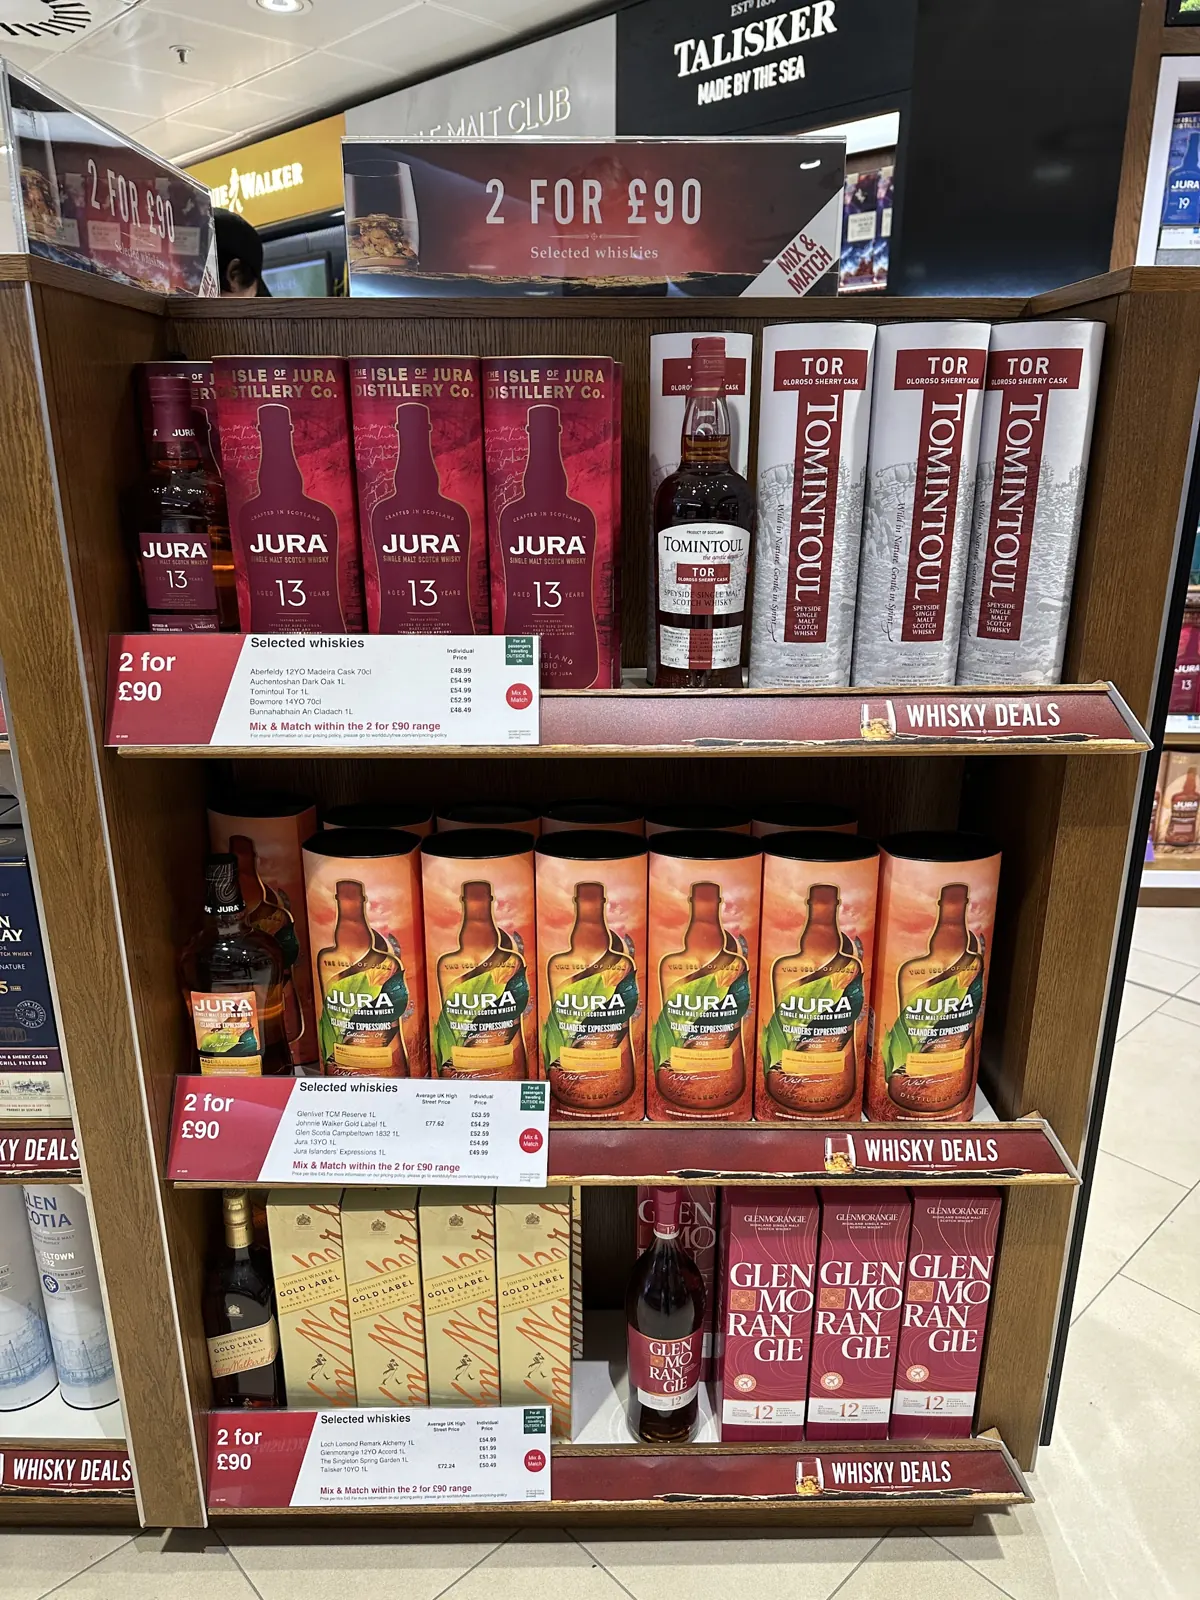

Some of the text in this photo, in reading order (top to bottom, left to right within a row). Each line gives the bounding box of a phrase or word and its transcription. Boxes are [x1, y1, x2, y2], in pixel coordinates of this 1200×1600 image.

[673, 0, 838, 78] TALISKER
[697, 54, 806, 106] MADE BY THE SEA
[507, 86, 572, 134] CLUB
[240, 162, 304, 200] WALKER
[1171, 180, 1200, 189] JURA
[87, 158, 175, 243] 2 FOR £90
[485, 178, 702, 225] 2 FOR £90
[1178, 197, 1190, 210] 19
[530, 246, 659, 259] Selected whiskies
[776, 233, 817, 275] MIX &
[787, 245, 833, 295] MATCH
[371, 367, 474, 382] ISLE OF JURA
[801, 357, 844, 376] TOR
[927, 355, 968, 375] TOR
[1007, 356, 1050, 376] TOR
[232, 368, 336, 383] ISLE OF JURA
[503, 369, 605, 384] ISLE OF JURA
[782, 377, 859, 386] OLOROSO SHERRY CASK
[355, 384, 475, 398] DISTILLERY Co.
[581, 385, 606, 399] Co.
[795, 394, 839, 602] TOMINTOUL
[914, 393, 963, 601] TOMINTOUL
[989, 393, 1042, 598] TOMINTOUL
[143, 542, 208, 559] JURA
[250, 533, 329, 553] JURA
[382, 534, 461, 553] JURA
[509, 535, 586, 555] JURA
[664, 536, 744, 555] TOMINTOUL
[382, 555, 461, 564] SINGLE MALT SCOTCH WHISKY
[166, 570, 188, 589] 13
[692, 566, 715, 577] TOR
[275, 579, 307, 607] 13
[407, 579, 438, 607] 13
[533, 581, 563, 608] 13
[793, 605, 821, 613] SPEYSIDE
[250, 637, 365, 649] Selected whiskies
[793, 629, 818, 637] WHISKY
[119, 651, 176, 672] 2 for
[118, 681, 162, 701] £90
[906, 702, 1061, 728] WHISKY DEALS
[249, 722, 441, 732] Mix & Match within the 2 for £90 range
[194, 999, 253, 1013] JURA
[326, 990, 394, 1009] JURA
[446, 991, 517, 1009] JURA
[556, 993, 626, 1011] JURA
[667, 993, 738, 1010] JURA
[780, 996, 852, 1013] JURA
[906, 994, 974, 1014] JURA
[449, 1020, 513, 1032] ISLANDERS' EXPRESSIONS
[783, 1025, 848, 1036] ISLANDERS' EXPRESSIONS
[299, 1081, 398, 1093] Selected whiskies
[183, 1093, 235, 1112] 2 for
[181, 1120, 220, 1140] £90
[25, 1138, 79, 1161] DEALS
[864, 1138, 999, 1162] WHISKY DEALS
[744, 1214, 807, 1224] GLENMORANGIE
[729, 1262, 815, 1288] GLEN
[820, 1260, 904, 1287] GLEN
[909, 1253, 994, 1280] GLEN
[279, 1274, 341, 1298] GOLD LABEL
[427, 1275, 491, 1299] GOLD LABEL
[935, 1280, 991, 1305] MO
[758, 1288, 814, 1314] MO
[848, 1286, 903, 1311] MO
[727, 1312, 793, 1338] RAN
[815, 1311, 882, 1336] RAN
[902, 1304, 971, 1328] RAN
[213, 1337, 264, 1354] GOLD LABEL
[753, 1338, 804, 1362] GIE
[841, 1335, 891, 1360] GIE
[928, 1329, 978, 1353] GIE
[320, 1413, 411, 1424] Selected whiskies
[753, 1404, 774, 1420] 12
[217, 1427, 263, 1446] 2 for
[13, 1458, 132, 1481] WHISKY DEALS
[217, 1453, 252, 1471] £90
[831, 1460, 952, 1484] WHISKY DEALS
